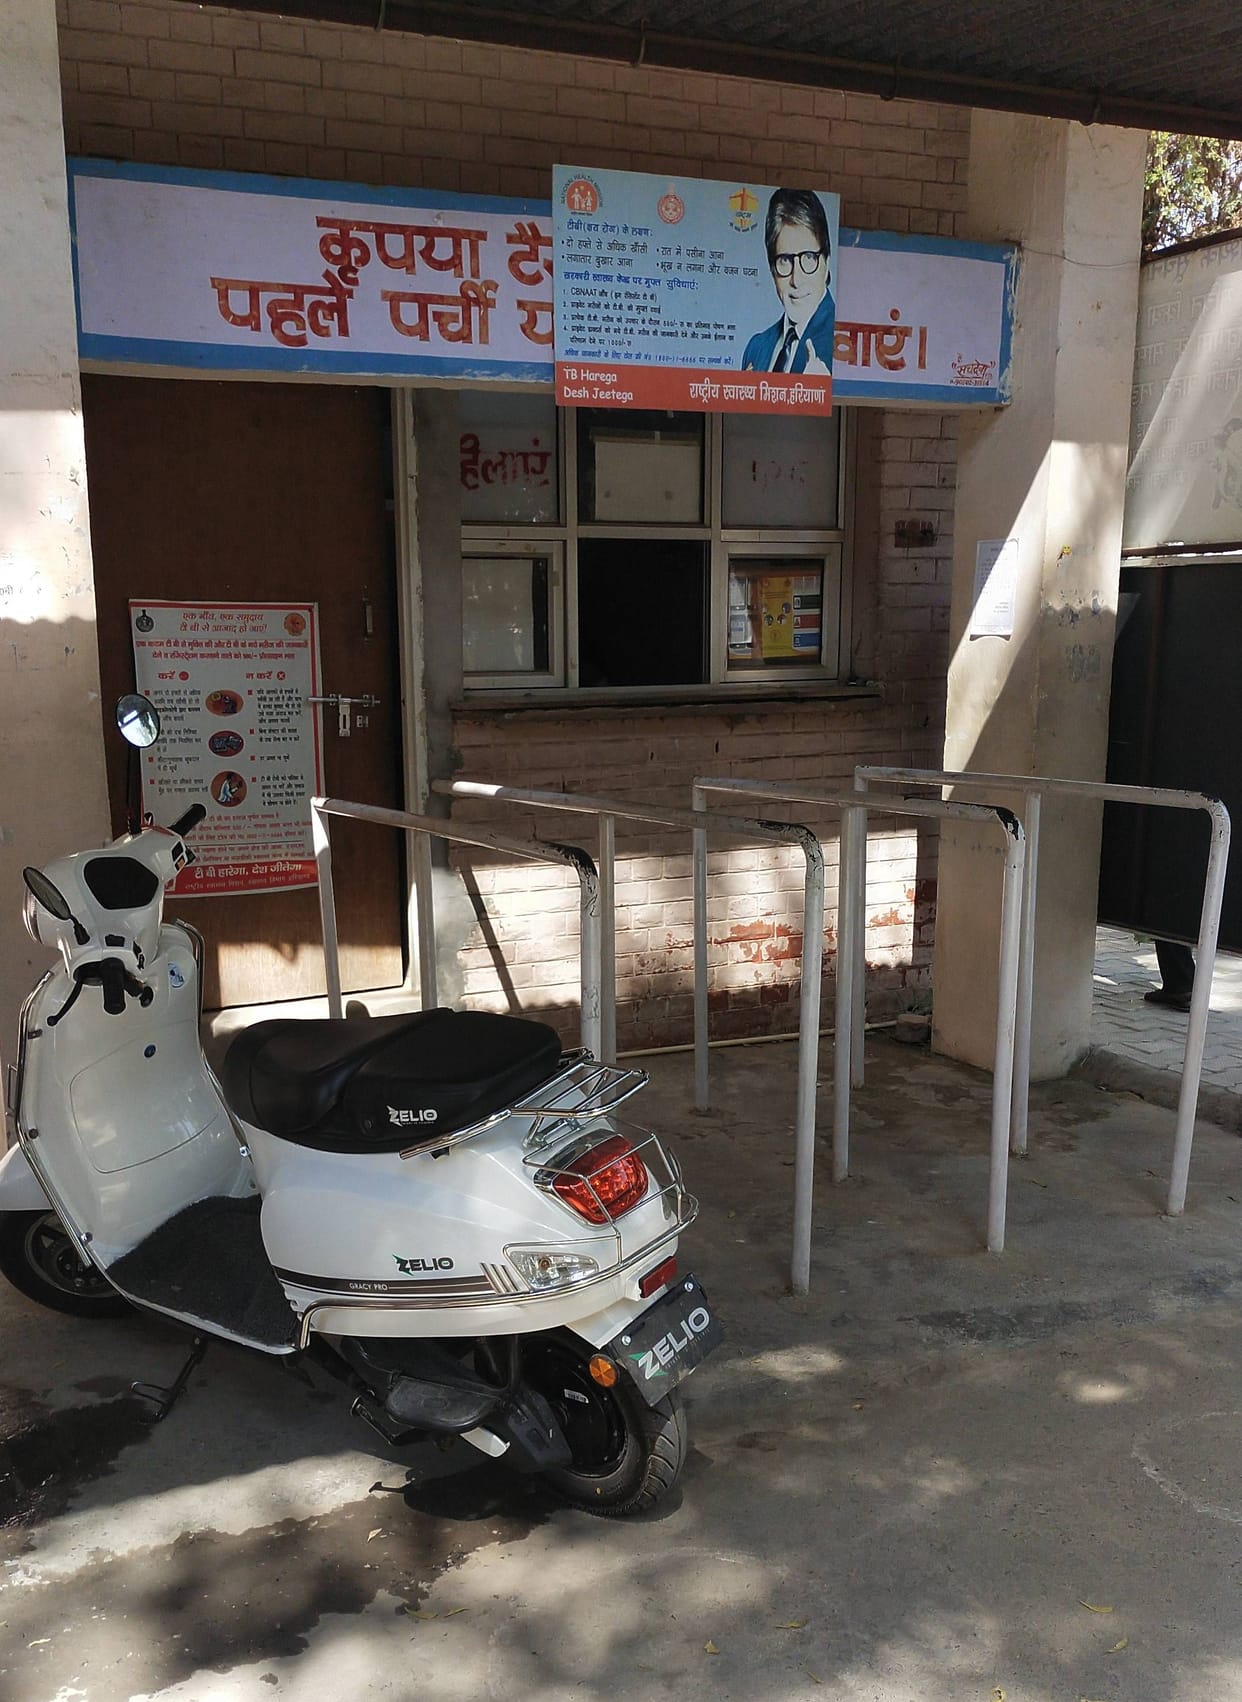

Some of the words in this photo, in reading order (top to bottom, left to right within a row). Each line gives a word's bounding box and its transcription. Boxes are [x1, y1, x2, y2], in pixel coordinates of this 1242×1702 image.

[622, 223, 629, 234] के
[316, 216, 488, 286] कृपया
[506, 222, 552, 286] टै
[596, 239, 602, 250] से
[607, 240, 627, 252] अधिक
[661, 247, 672, 256] रात
[686, 246, 705, 258] पसीना
[709, 250, 724, 260] आना
[566, 253, 591, 264] लगातार
[595, 255, 613, 268] बुखार
[617, 257, 633, 268] आना
[661, 261, 673, 273] भूख
[677, 263, 683, 272] न
[686, 263, 704, 273] लगना
[708, 262, 720, 274] और
[724, 266, 739, 276] वजन
[743, 268, 759, 277] घटना
[633, 276, 643, 285] पर
[571, 287, 597, 297] CBNAAT
[210, 269, 354, 347] पहले
[381, 279, 499, 345] पर्ची
[833, 308, 927, 371] वाएं।
[563, 367, 577, 380] TB
[581, 369, 617, 385] Harega
[564, 386, 589, 399] Desh
[592, 387, 633, 403] Jeetega
[689, 377, 721, 403] राष्ट्रीय
[723, 384, 757, 401] स्वास्थ्य
[158, 670, 176, 681] करें
[257, 670, 273, 681] करें
[195, 866, 204, 879] टी
[206, 866, 216, 878] बी
[252, 863, 268, 874] देश
[270, 861, 302, 873] जीतेगा
[387, 1106, 438, 1125] ZELIO
[392, 1255, 454, 1275] ZELIO
[349, 1282, 372, 1291] GRACY
[373, 1282, 388, 1292] PRO
[637, 1307, 710, 1381] ZELIO
